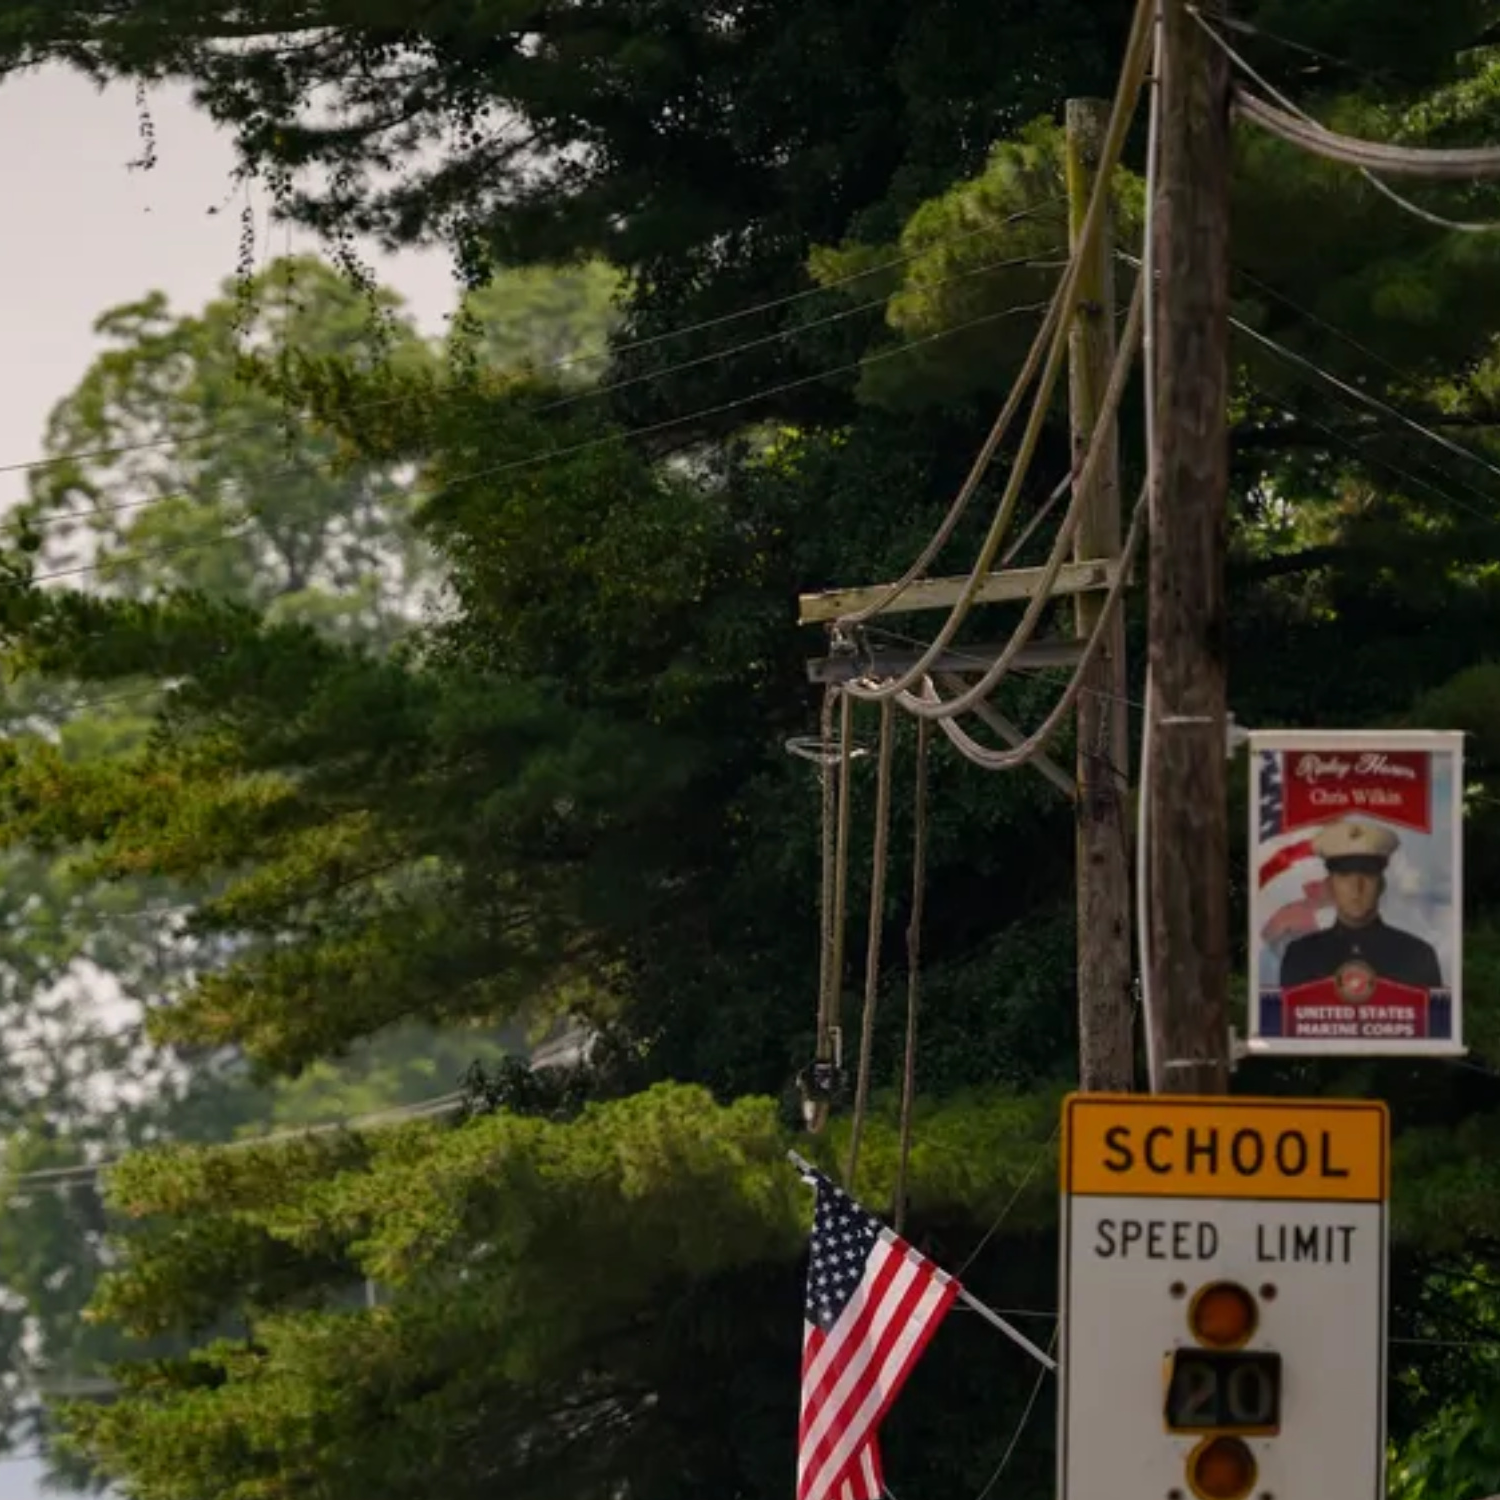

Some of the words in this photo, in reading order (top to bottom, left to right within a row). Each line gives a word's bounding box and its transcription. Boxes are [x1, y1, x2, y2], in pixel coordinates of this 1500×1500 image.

[1295, 1006, 1356, 1019] UNITED
[1359, 1006, 1415, 1019] STATES
[1296, 1023, 1358, 1036] MARINE
[1362, 1023, 1415, 1036] CORPS
[1103, 1126, 1350, 1178] SCHOOL
[1094, 1218, 1219, 1261] SPEED
[1256, 1223, 1357, 1264] LIMIT
[1178, 1360, 1272, 1426] 20
